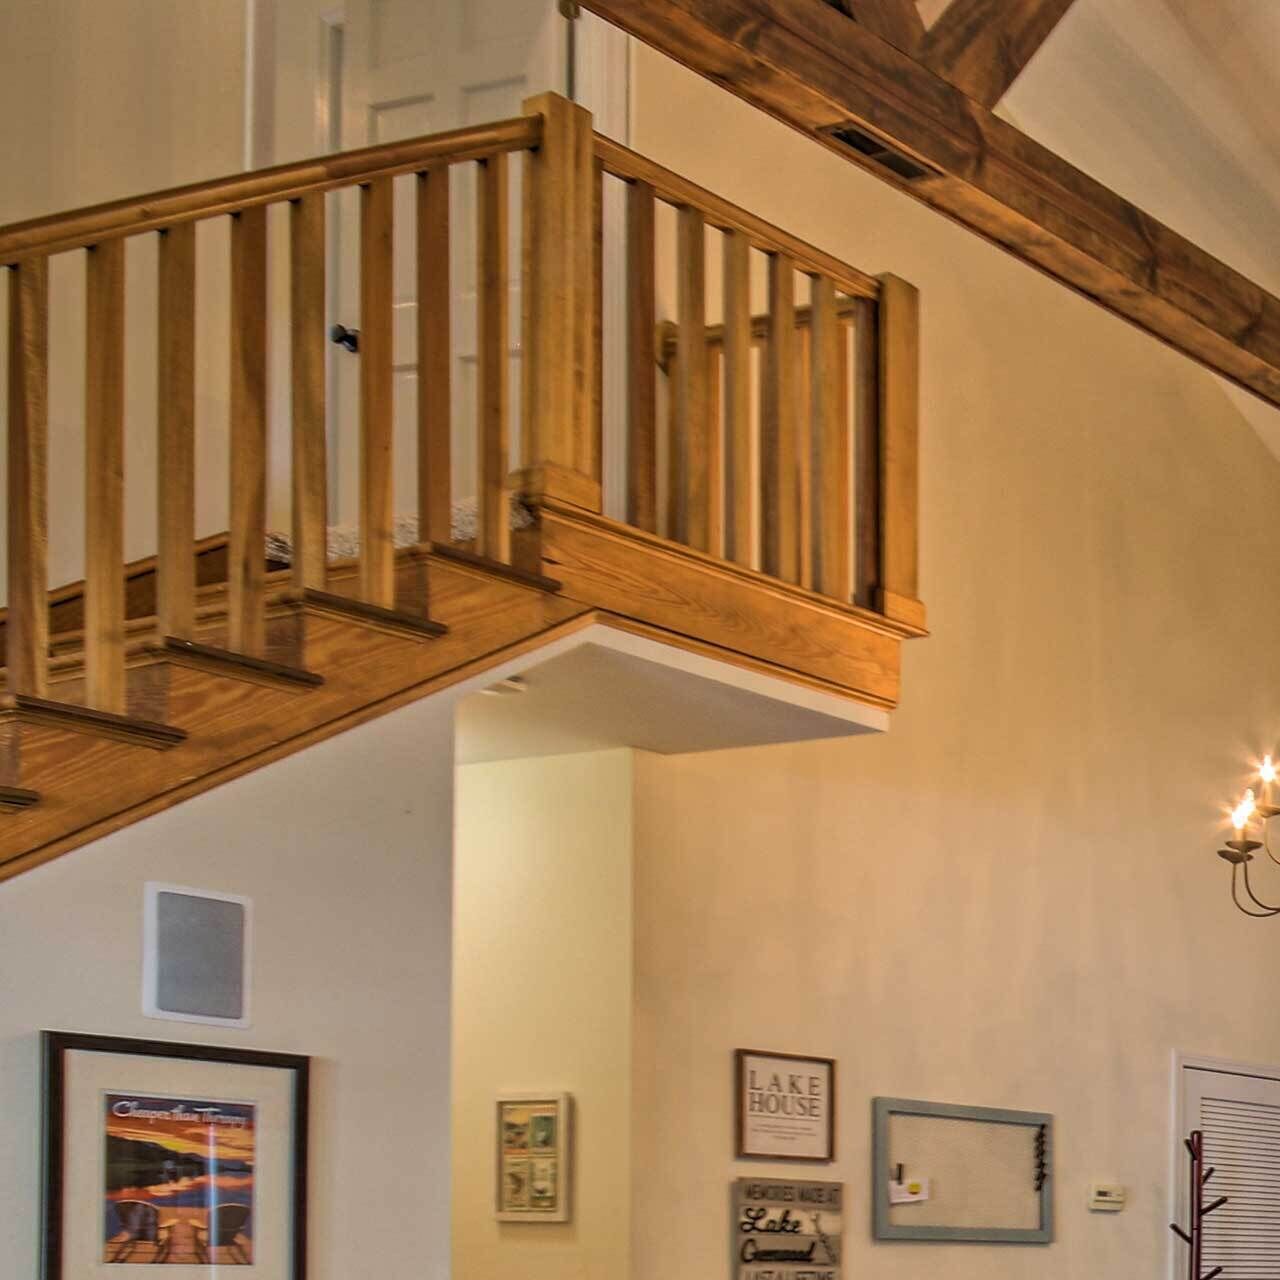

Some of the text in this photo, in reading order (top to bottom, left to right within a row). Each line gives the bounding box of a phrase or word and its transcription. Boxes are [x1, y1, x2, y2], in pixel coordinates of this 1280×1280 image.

[750, 1070, 820, 1095] LAKE
[750, 1092, 820, 1117] HOUSE
[741, 1207, 801, 1233] Lake
